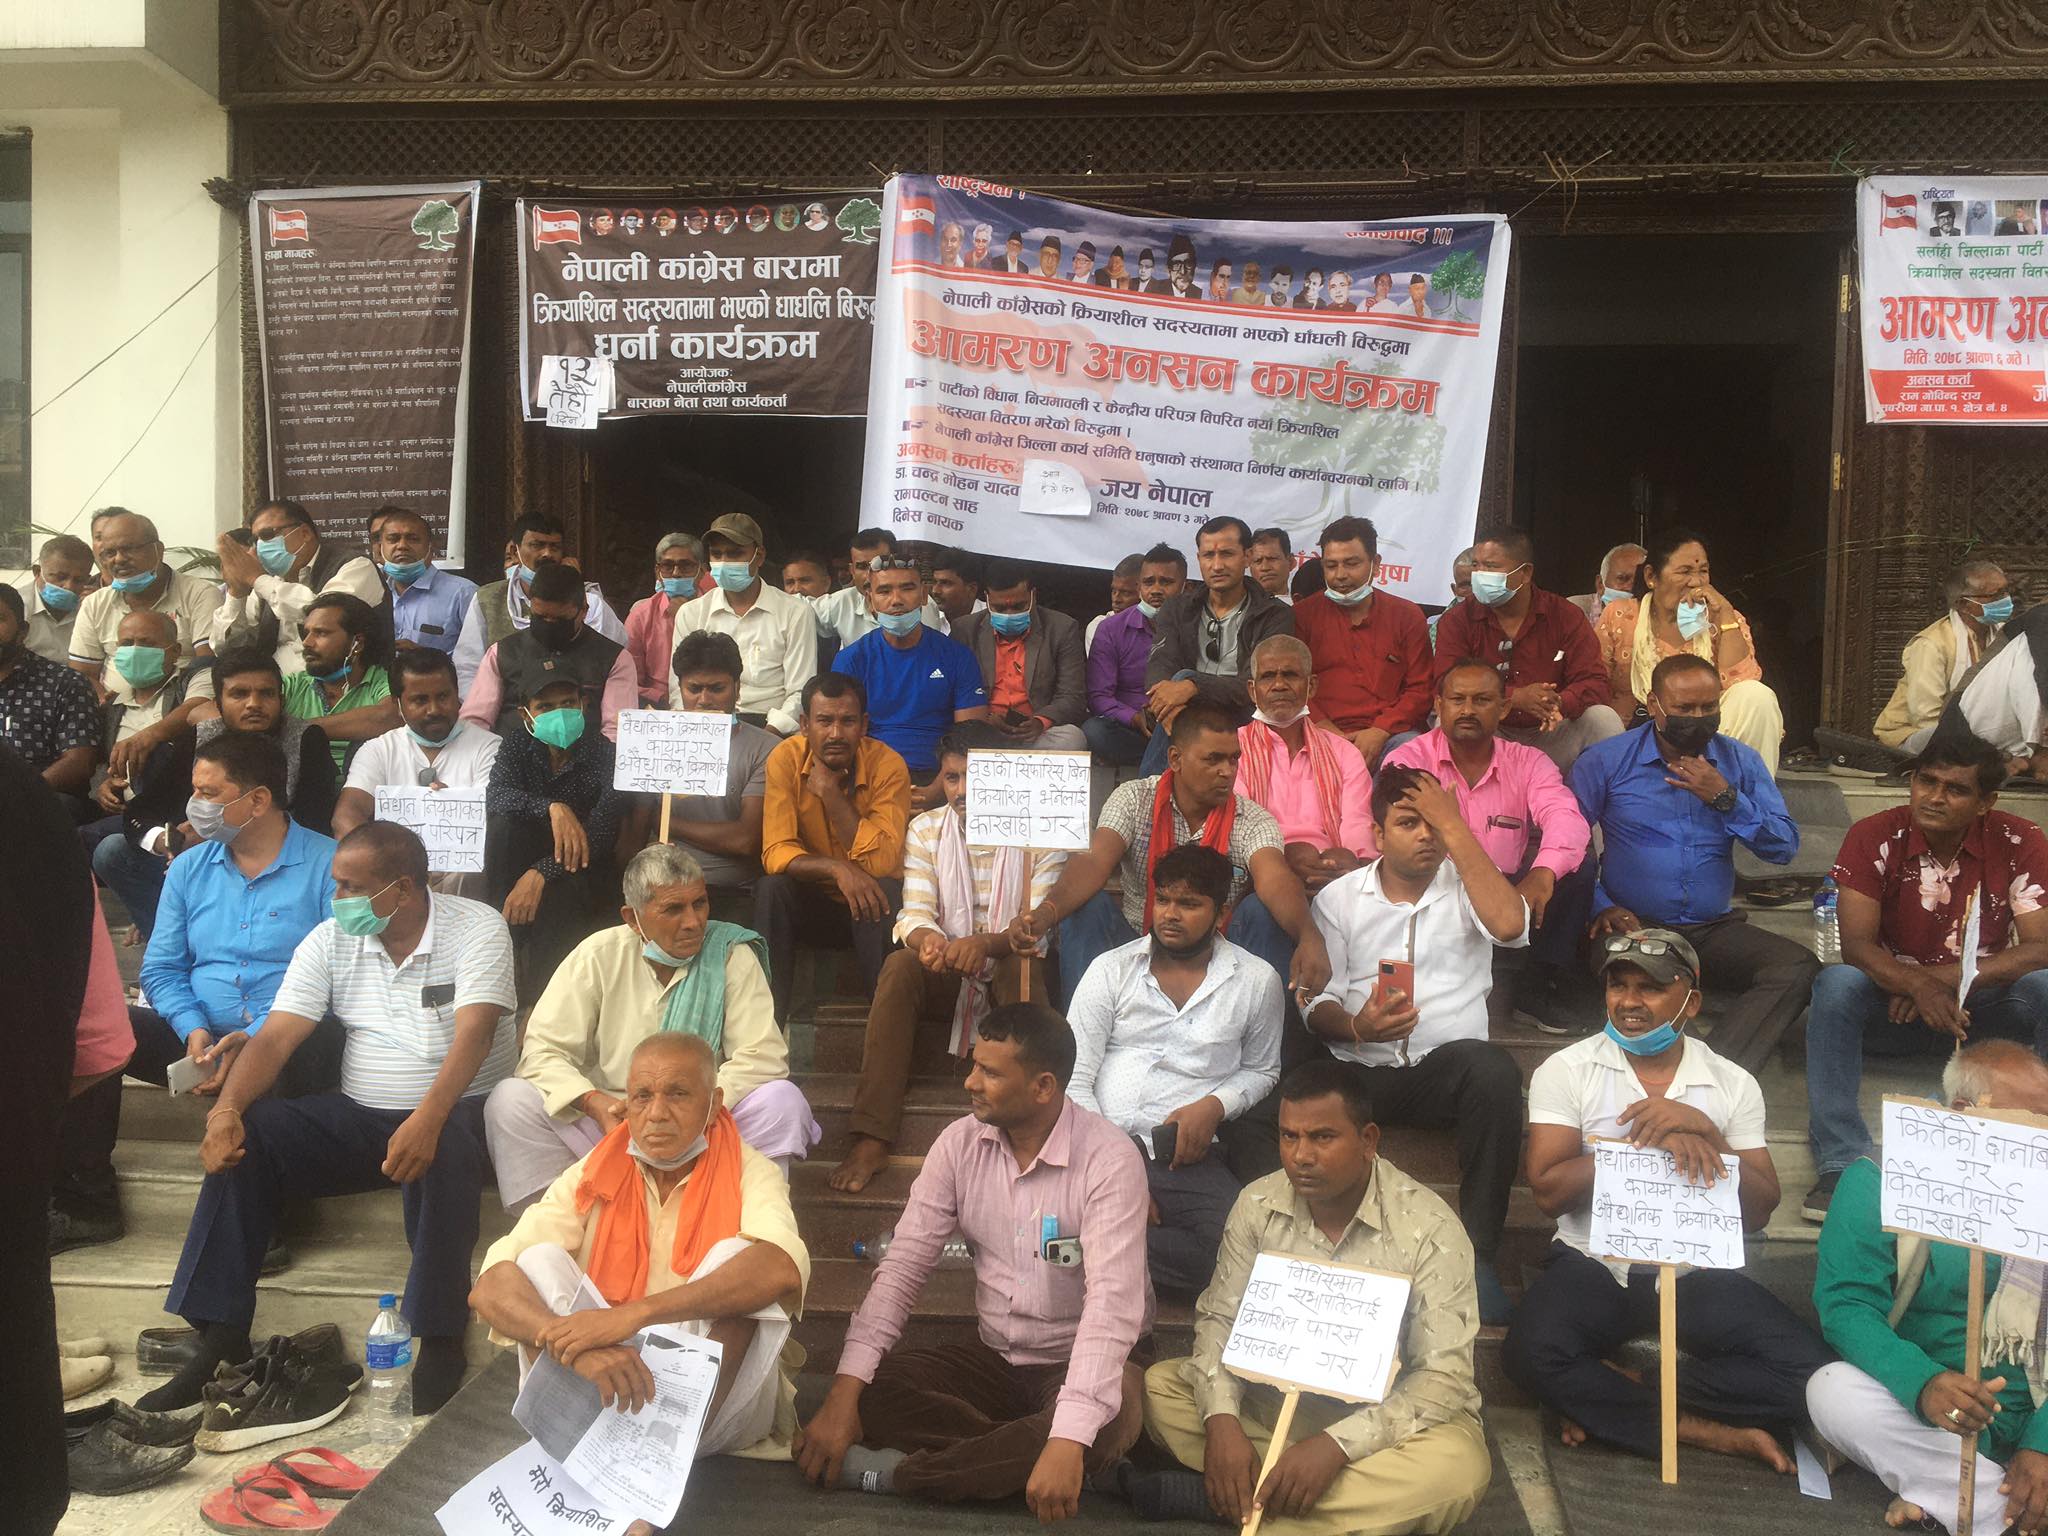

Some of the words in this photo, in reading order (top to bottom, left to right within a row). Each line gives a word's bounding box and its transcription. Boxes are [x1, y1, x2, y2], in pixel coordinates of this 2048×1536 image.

[1958, 241, 2010, 258] जिल्लाका
[2018, 240, 2043, 257] पार्टी
[561, 251, 650, 282] नेपाली
[658, 251, 745, 283] कांग्रेस
[753, 255, 842, 280] बारामा
[1908, 264, 1963, 280] क्रियाशिल
[1969, 267, 2017, 280] सदस्यता
[533, 291, 617, 324] क्रियाशिल
[622, 297, 715, 322] सदस्यतामा
[720, 289, 770, 319] भएको
[943, 288, 992, 309] नेपाली
[997, 294, 1066, 317] काँग्रेसको
[1071, 302, 1148, 328] क्रियाशील
[1153, 317, 1238, 338] सदस्यतामा
[1243, 327, 1290, 343] भएको
[1880, 296, 2000, 343] आमरण
[670, 324, 819, 360] कार्यक्रम
[911, 319, 1072, 375] आमरण
[1082, 343, 1240, 391] अनसन
[1250, 360, 1440, 416] कार्यक्रम
[1934, 353, 1961, 364] २०७८
[1966, 352, 1994, 366] श्रावण
[2006, 351, 2023, 366] गते
[1907, 375, 1944, 386] अनसन
[1948, 372, 1972, 386] कर्ता
[627, 398, 670, 409] बाराका
[674, 395, 698, 408] नेता
[703, 397, 727, 408] तथा
[732, 394, 787, 408] कार्यकर्ता
[1900, 392, 1919, 400] राम
[1922, 390, 1958, 400] गोविन्द
[1961, 391, 1982, 400] राय
[937, 402, 986, 422] सदस्यता
[990, 410, 1031, 427] वितरण
[1034, 415, 1070, 431] गरेको
[939, 381, 979, 398] पार्टीको
[1026, 390, 1090, 411] नियमावली
[1093, 401, 1103, 413] र
[1105, 400, 1150, 418] केन्द्रीय
[1155, 405, 1196, 422] परिपत्र
[1200, 409, 1244, 428] विपरित
[1277, 419, 1340, 439] क्रियाशिल
[1963, 403, 1983, 413] क्षेत्र
[897, 442, 948, 462] अनसन
[935, 422, 972, 442] नेपाली
[1017, 436, 1057, 452] जिल्ला
[1092, 444, 1132, 460] समिति
[1135, 452, 1186, 467] धनुषाको
[1190, 454, 1244, 473] संस्थागत
[1247, 460, 1286, 477] निर्णय
[1378, 476, 1409, 491] लागि
[943, 472, 980, 491] मोहन
[984, 481, 1020, 496] यादव
[1100, 479, 1141, 499] जय
[1148, 479, 1214, 508] नेपाल
[894, 488, 949, 506] रामपल्टन
[953, 497, 979, 514] साह
[893, 507, 922, 523] दिनेस
[927, 512, 964, 531] नायक
[1153, 511, 1181, 522] श्रावण
[691, 742, 716, 760] गर
[968, 753, 1013, 777] वडाको
[1040, 816, 1080, 839] गर
[1956, 1159, 2002, 1190] गर
[1624, 1179, 1676, 1199] कायम
[1673, 1240, 1715, 1265] गर
[1248, 1280, 1282, 1301] वडा
